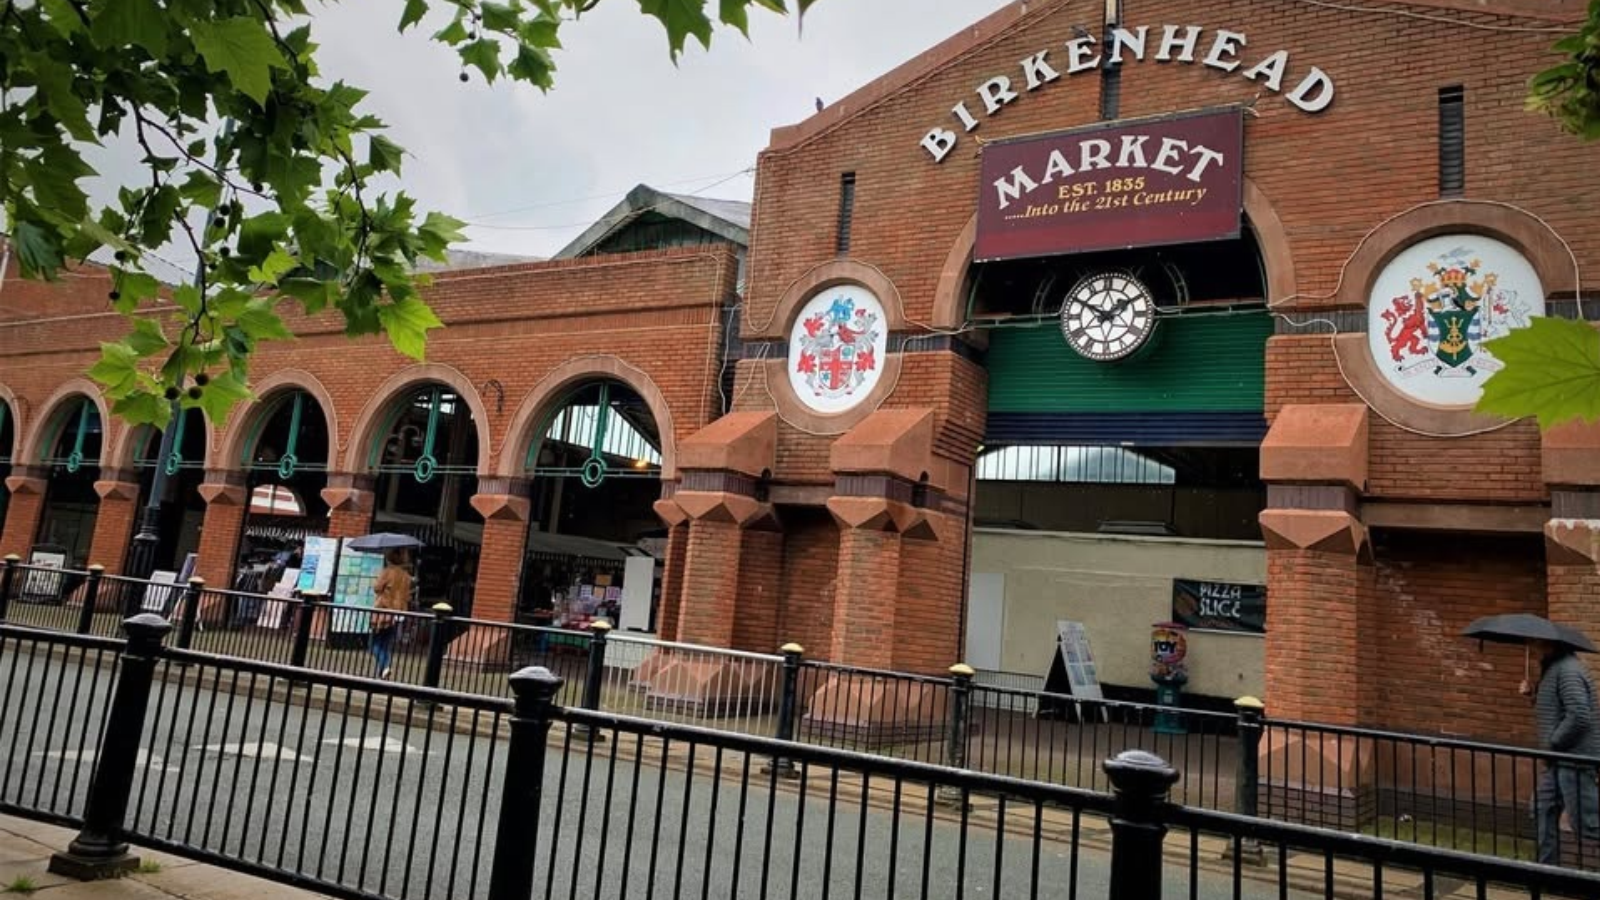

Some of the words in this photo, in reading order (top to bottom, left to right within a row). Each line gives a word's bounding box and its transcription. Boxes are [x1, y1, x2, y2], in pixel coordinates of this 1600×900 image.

[920, 24, 1335, 163] BIRKENHEAD
[993, 135, 1224, 210] MARKET
[1058, 181, 1098, 200] EST.
[1105, 176, 1145, 194] 1835
[1063, 198, 1091, 214] the
[1095, 193, 1129, 210] 21st
[1133, 187, 1207, 206] Century
[1200, 583, 1242, 599] PIZZA
